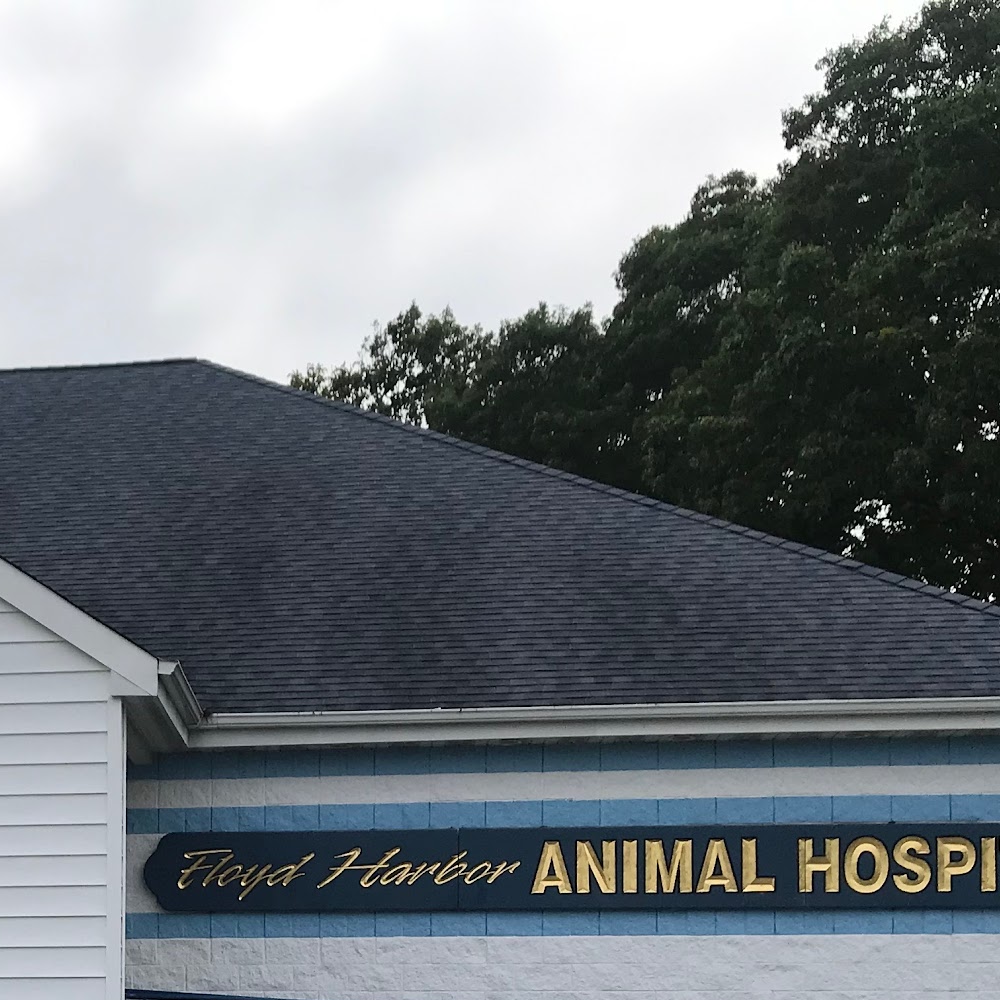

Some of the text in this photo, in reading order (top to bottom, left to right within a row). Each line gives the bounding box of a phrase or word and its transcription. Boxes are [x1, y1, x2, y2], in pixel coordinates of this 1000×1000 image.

[177, 836, 996, 901] Floyd Harbor ANIMAL HOSPI
